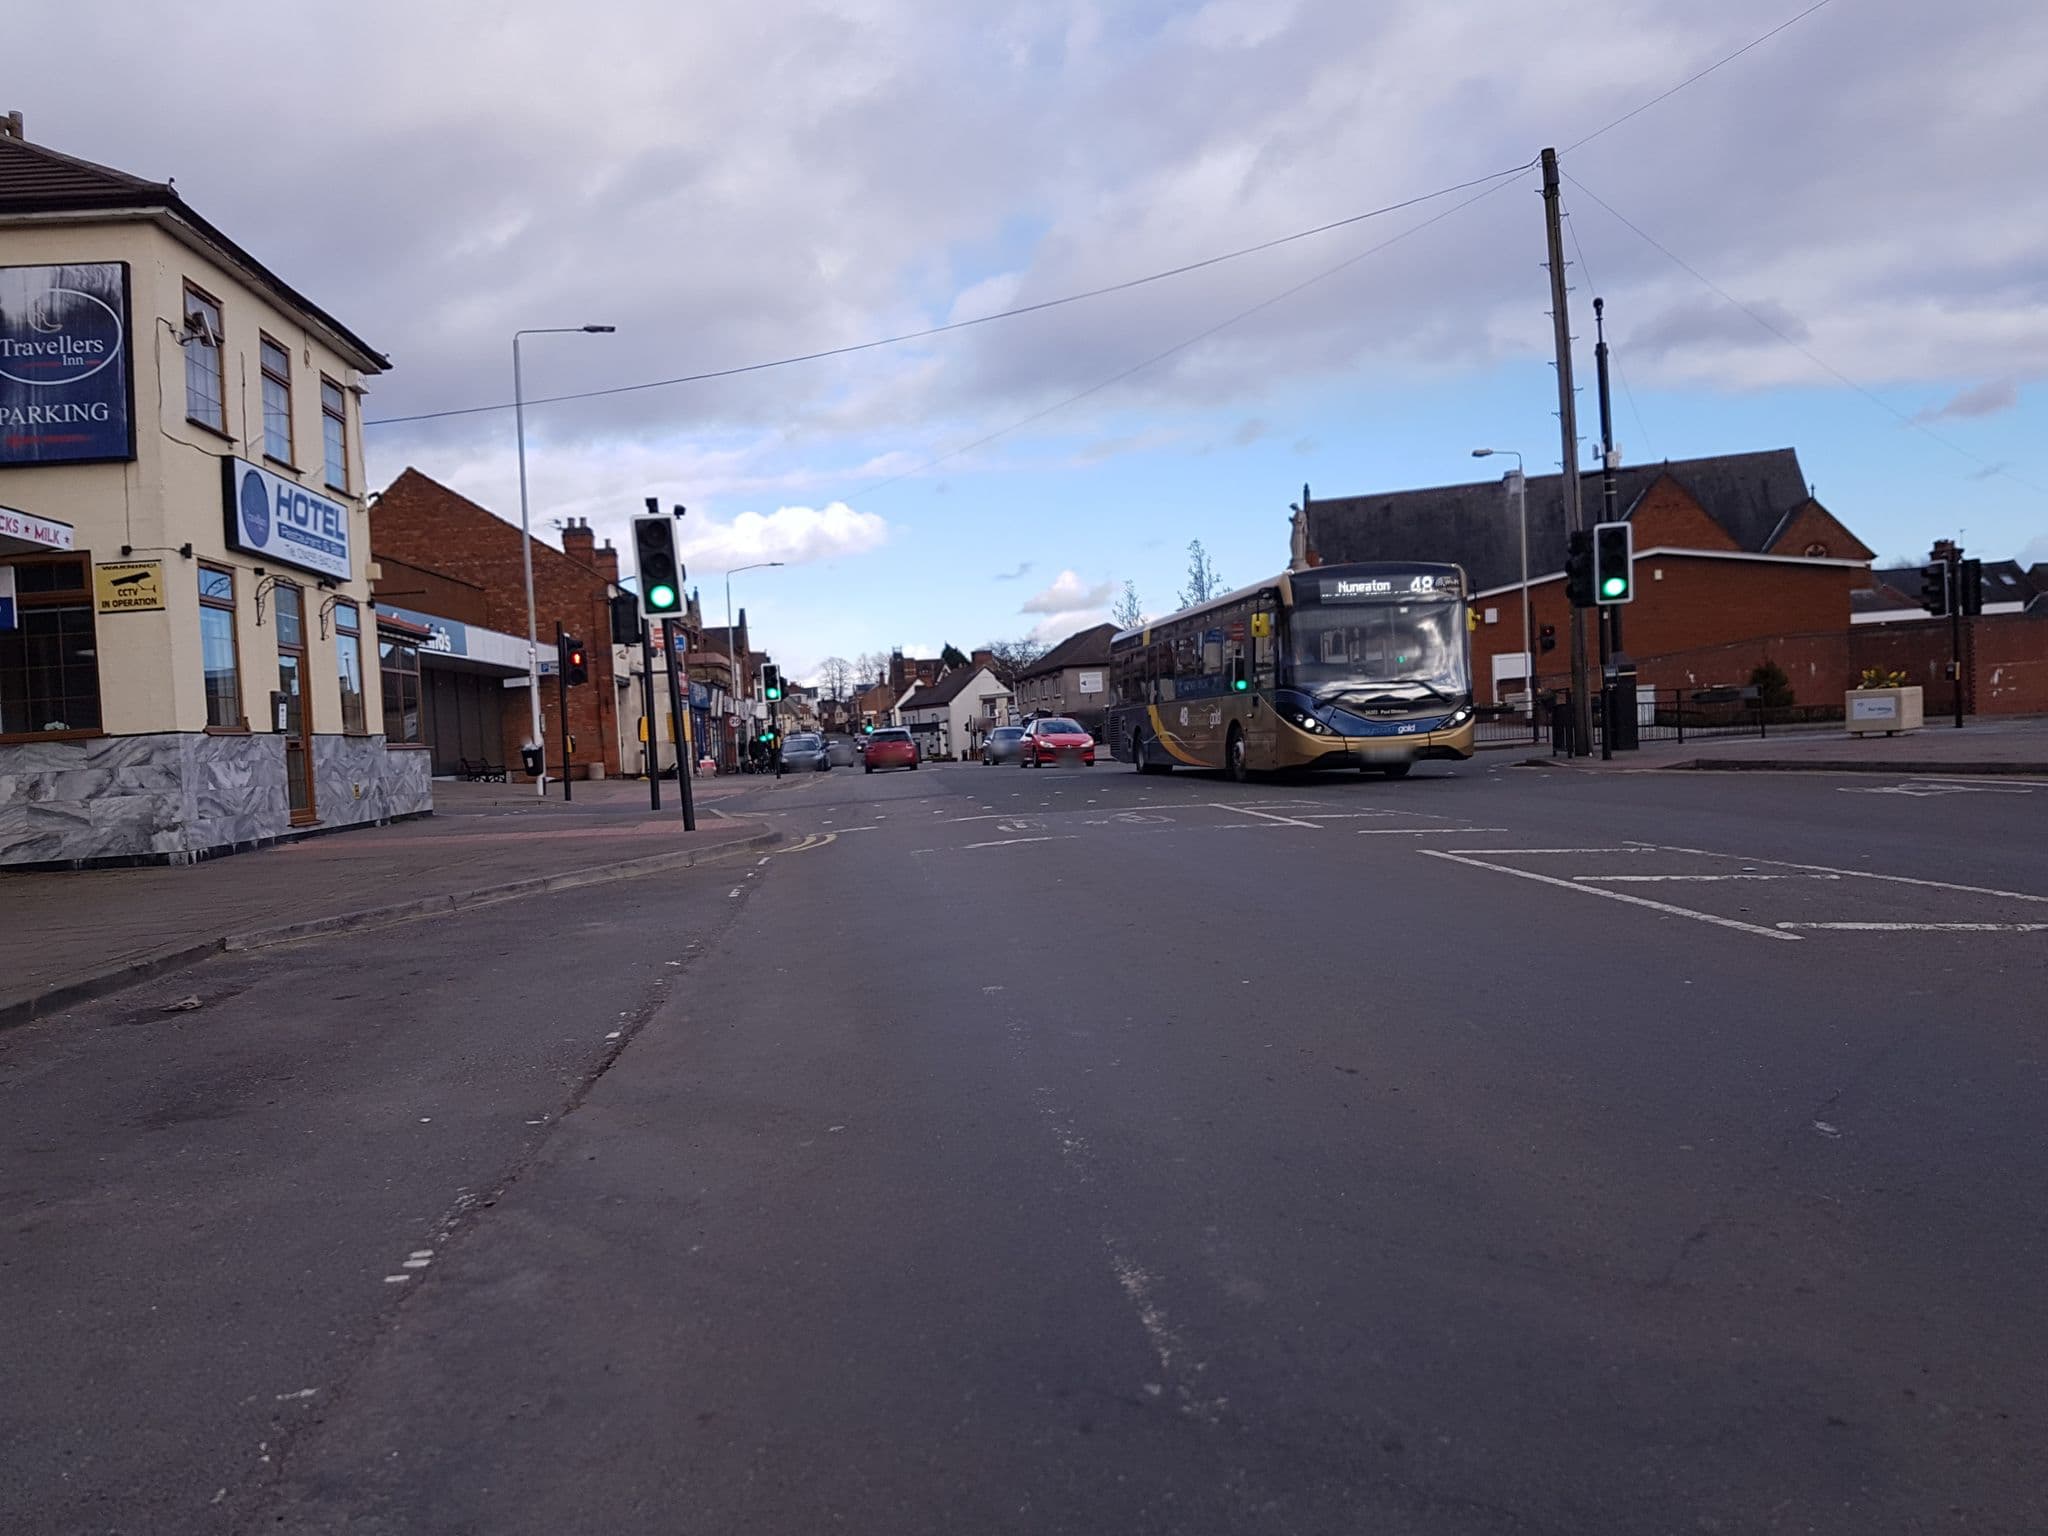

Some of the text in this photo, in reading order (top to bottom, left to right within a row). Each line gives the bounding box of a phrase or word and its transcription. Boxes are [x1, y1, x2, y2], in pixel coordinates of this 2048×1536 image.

[1, 335, 104, 357] Travellers
[62, 354, 85, 366] Inn
[0, 402, 109, 426] PARKING
[277, 484, 345, 541] HOTEL
[1338, 580, 1391, 593] Nuneaton
[1410, 576, 1434, 593] 48
[118, 588, 139, 597] CCTV
[102, 598, 158, 608] IN OPERATION
[1397, 724, 1416, 734] gold
